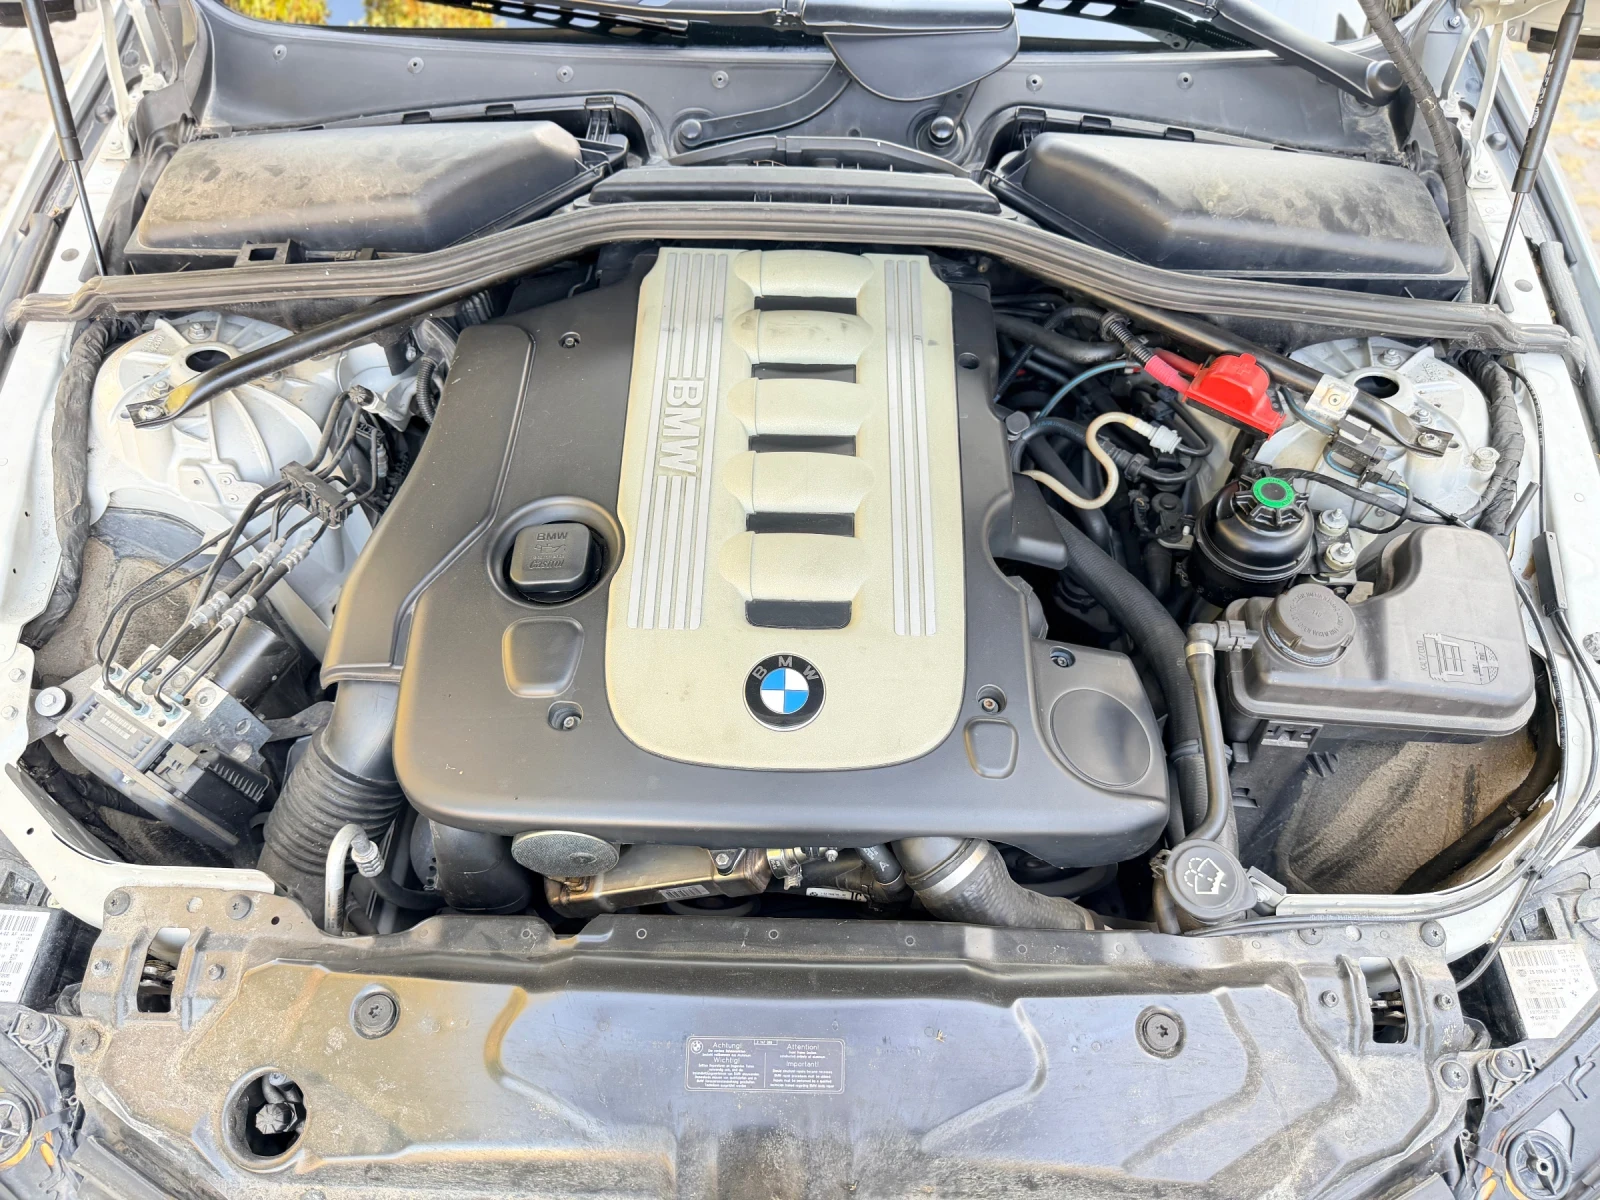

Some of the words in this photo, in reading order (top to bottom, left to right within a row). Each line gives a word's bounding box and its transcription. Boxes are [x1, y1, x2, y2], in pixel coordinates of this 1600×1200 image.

[659, 379, 704, 473] BMW
[537, 532, 568, 541] BMW
[530, 559, 564, 569] Castrol
[752, 655, 820, 681] BMW
